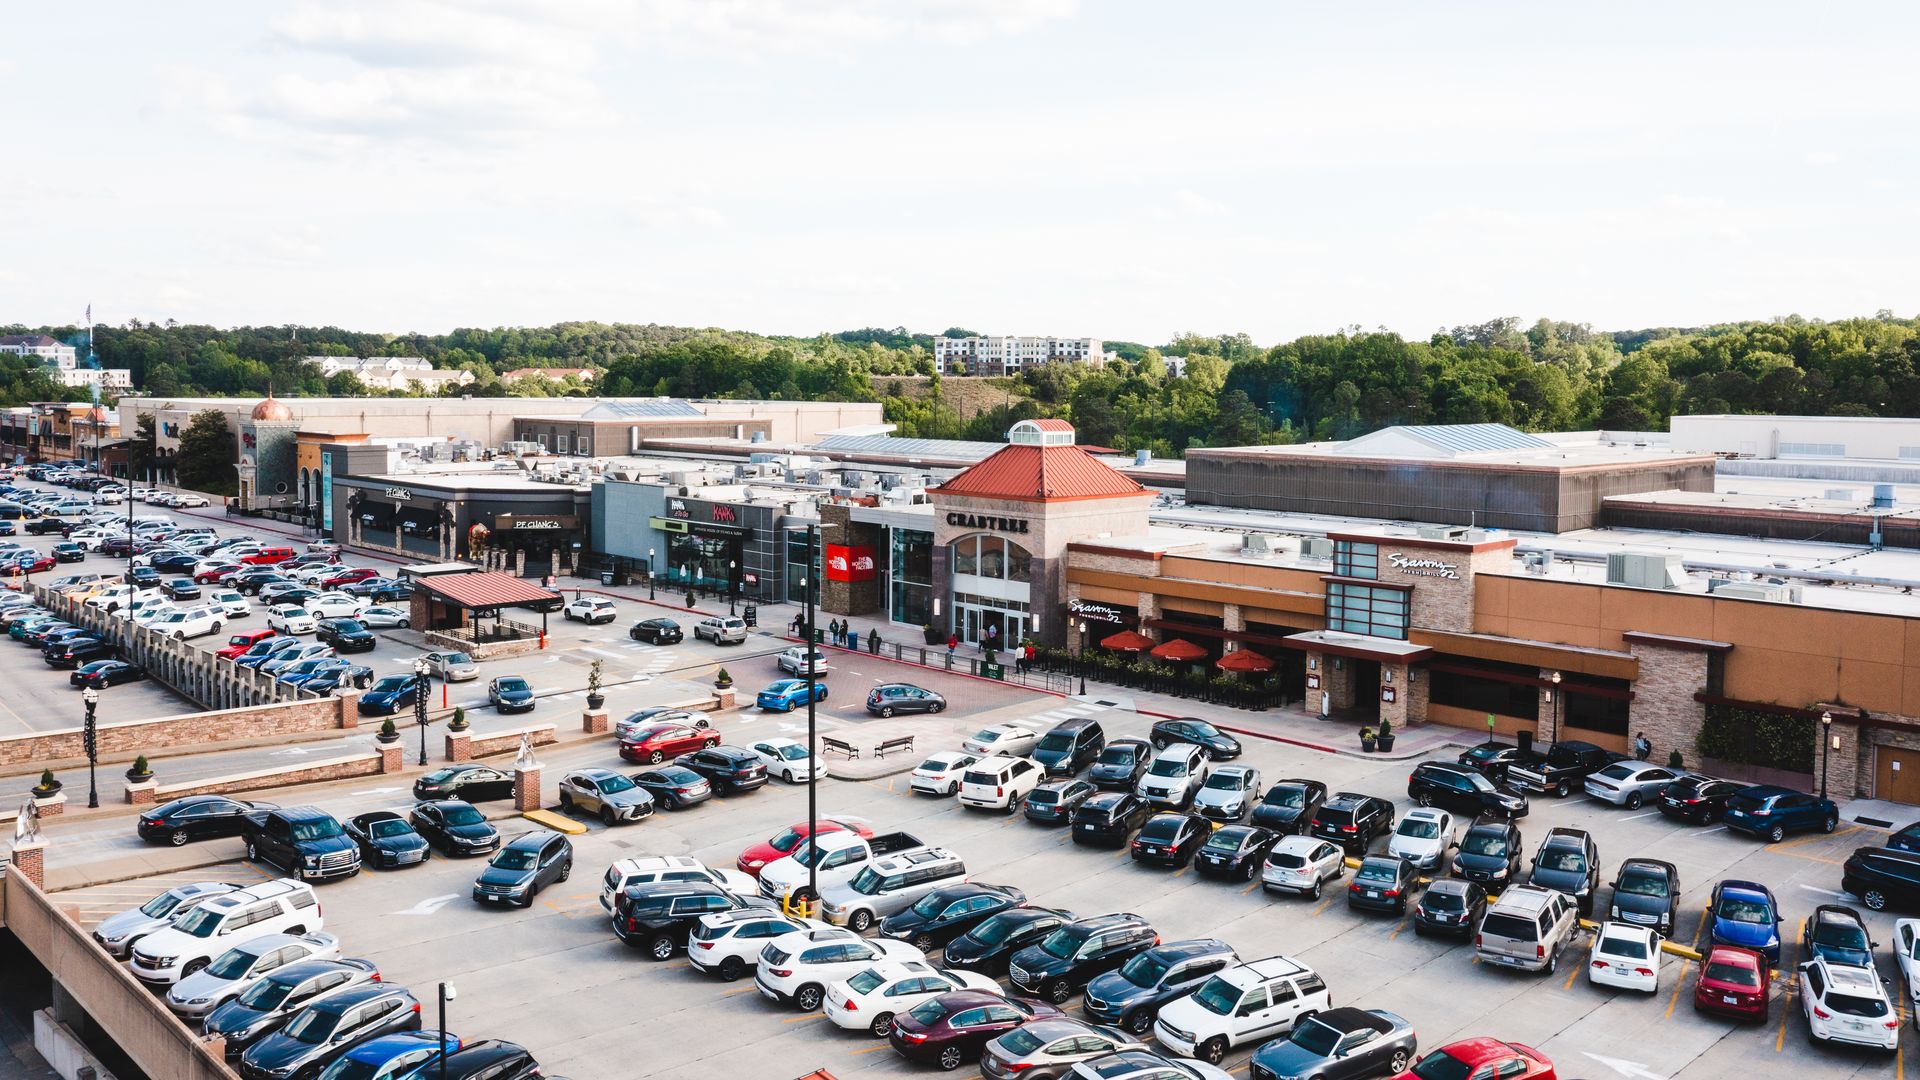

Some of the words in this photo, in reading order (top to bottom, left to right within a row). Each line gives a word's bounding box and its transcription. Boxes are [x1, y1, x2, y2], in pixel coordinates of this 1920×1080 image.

[946, 512, 1029, 534] CRABTREE
[1387, 552, 1444, 569] Seasons
[1440, 564, 1460, 580] 52
[1070, 598, 1111, 613] Seasons
[1108, 610, 1123, 623] 52
